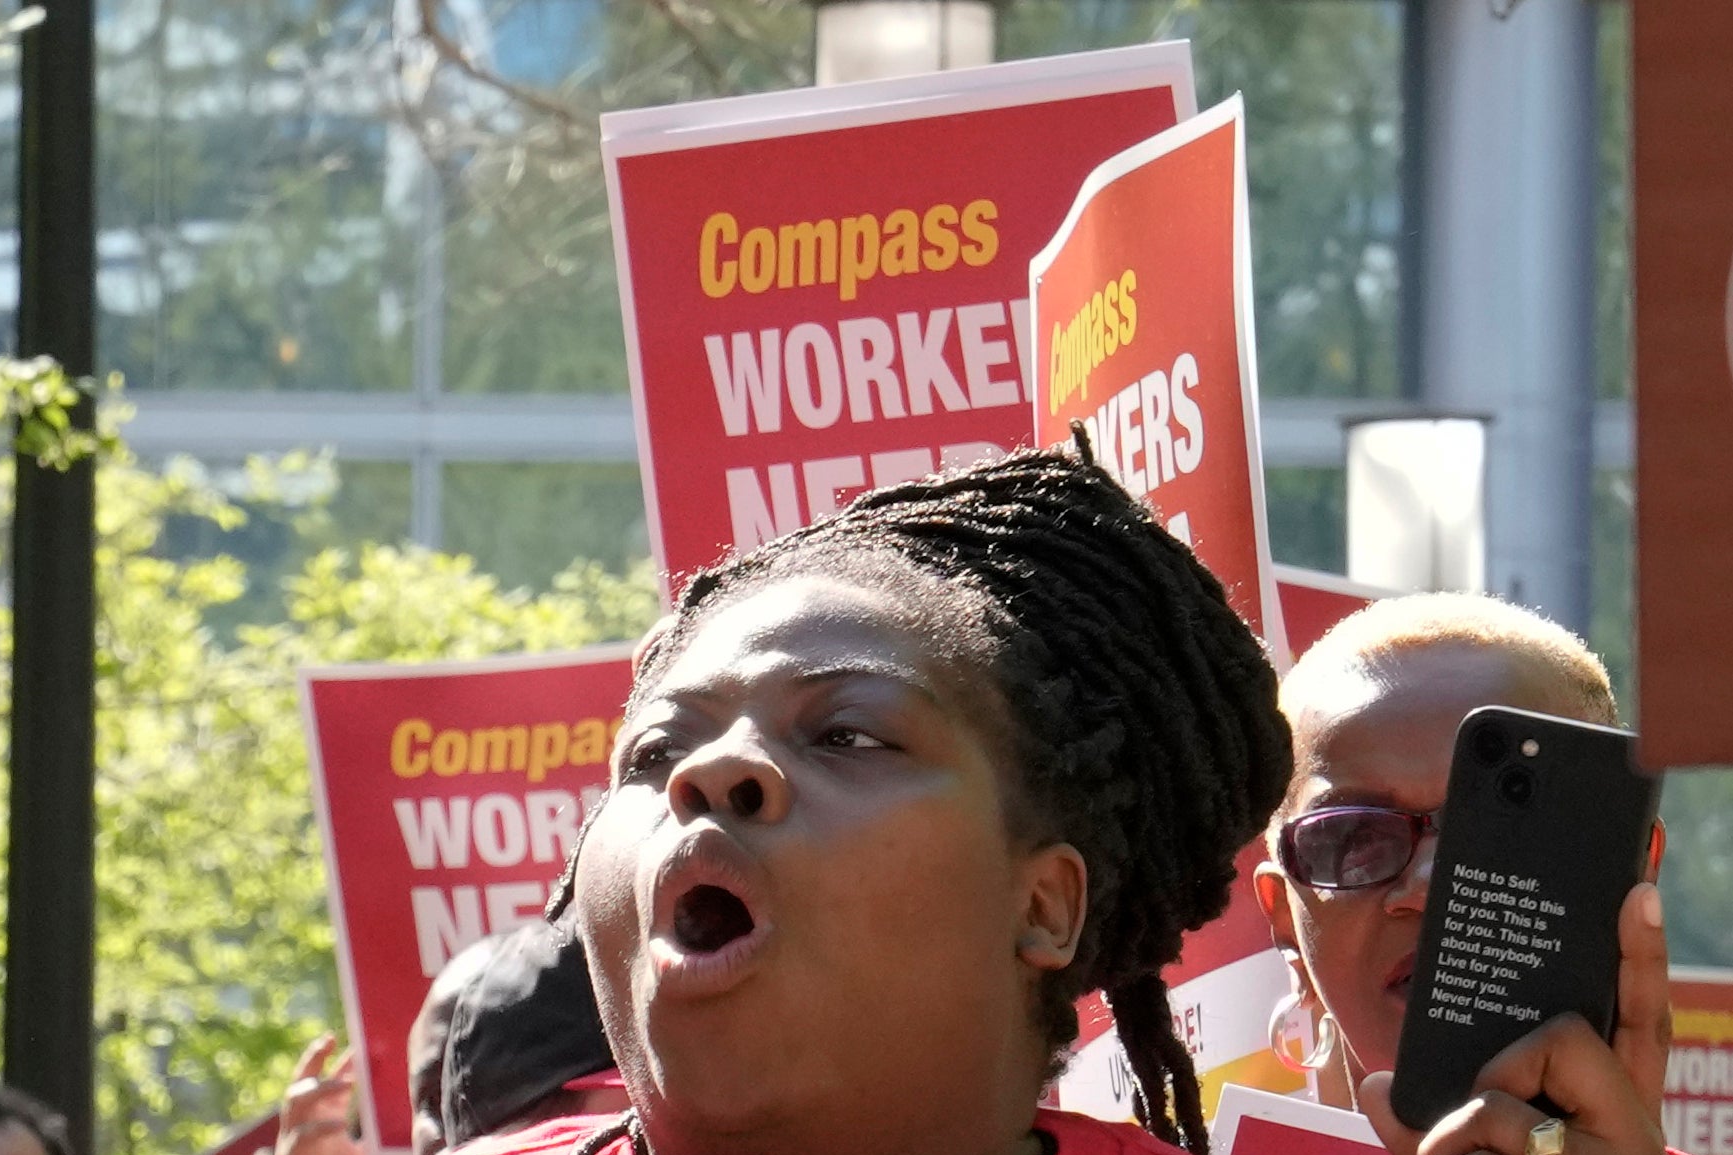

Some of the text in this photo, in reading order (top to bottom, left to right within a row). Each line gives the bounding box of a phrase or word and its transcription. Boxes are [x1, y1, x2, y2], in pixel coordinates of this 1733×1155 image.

[699, 200, 999, 301] Compass
[1049, 269, 1137, 416] Compass
[392, 785, 609, 869] WOR
[1453, 863, 1540, 893] Note to Self:
[1448, 899, 1547, 931] for you. This is
[1452, 881, 1566, 916] You gotta do this
[1444, 917, 1562, 952] for you. This isn't
[1438, 952, 1521, 980] Live for you.
[1441, 936, 1544, 969] about anybody.
[1434, 970, 1508, 996] Honor you.
[1428, 1006, 1474, 1026] of that.
[1431, 987, 1541, 1021] Never lose sight
